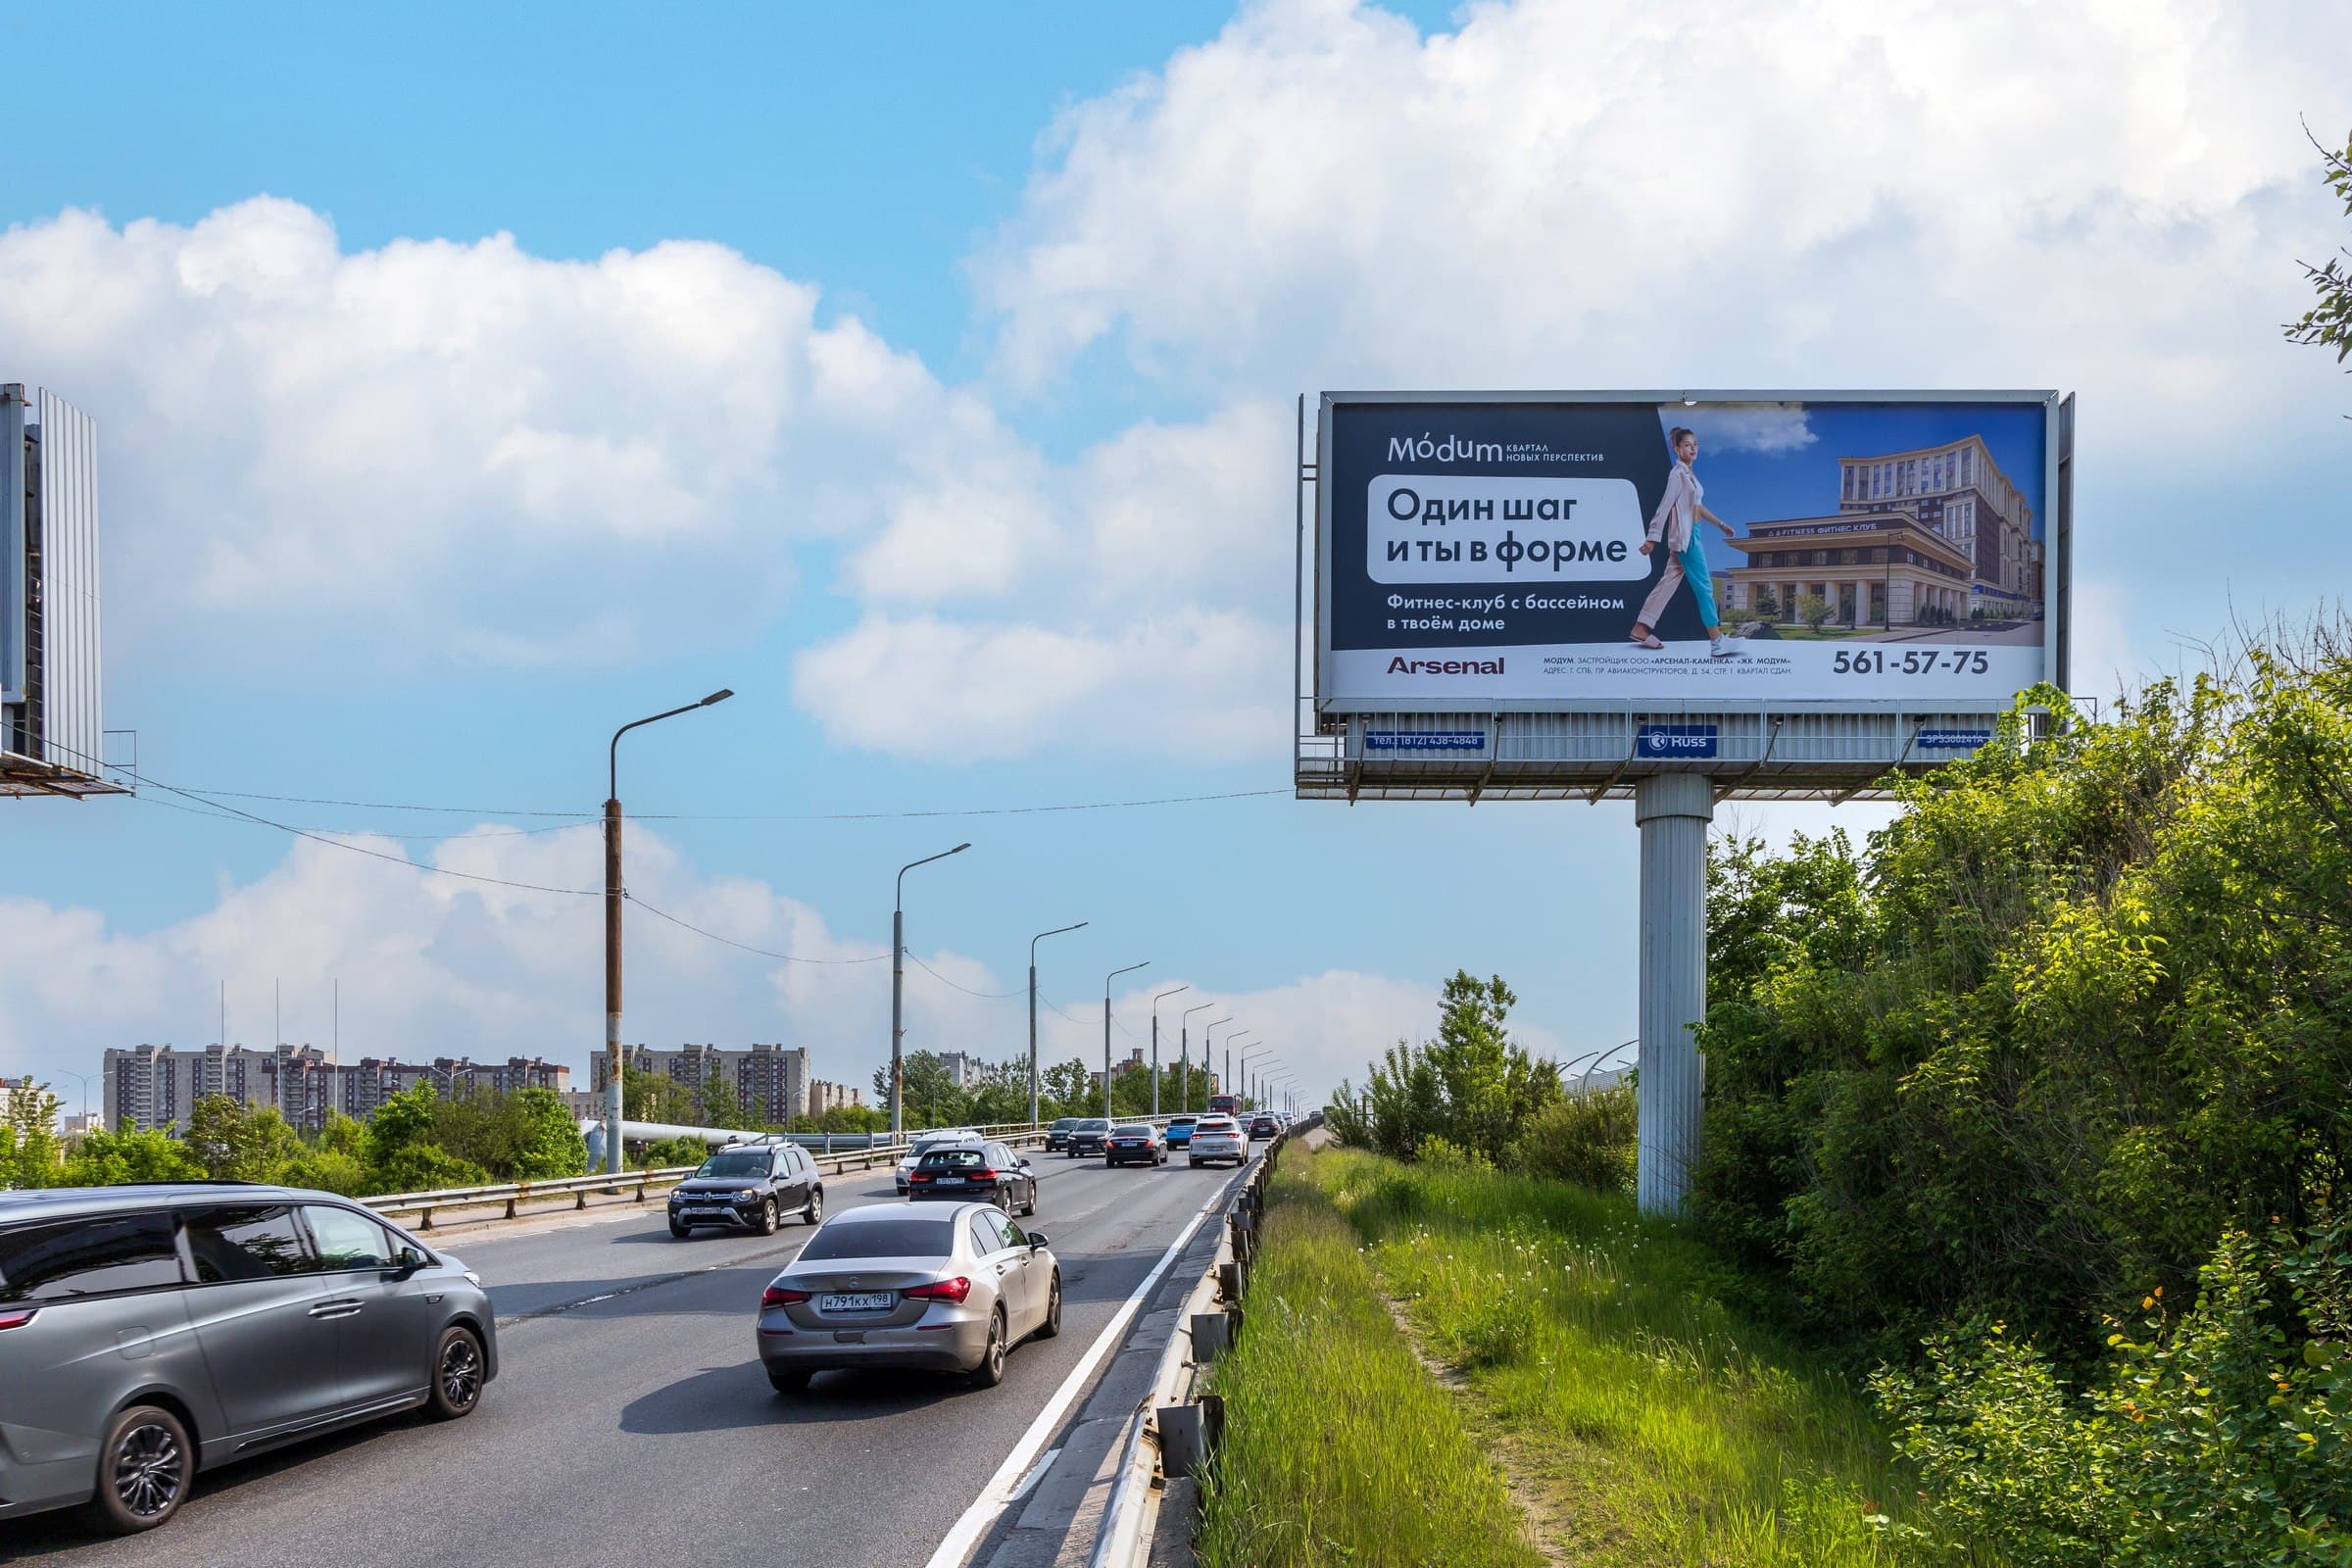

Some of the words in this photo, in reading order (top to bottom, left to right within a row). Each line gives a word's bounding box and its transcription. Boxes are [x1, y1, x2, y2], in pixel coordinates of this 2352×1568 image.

[1387, 431, 1503, 463] Módum
[1387, 487, 1494, 525] Один
[1502, 498, 1577, 520] шаг
[1817, 525, 1852, 534] ФИТНЕС
[1853, 523, 1878, 532] КЛУБ
[1387, 540, 1409, 563] и
[1416, 540, 1461, 563] ты
[1469, 540, 1489, 563] в
[1495, 530, 1628, 572] форме
[1387, 593, 1506, 613] Фитнес-клуб
[1511, 597, 1520, 610] с
[1525, 593, 1625, 610] бассейном
[1387, 618, 1396, 629] в
[1400, 615, 1454, 630] твоём
[1458, 618, 1506, 632] доме
[1386, 657, 1505, 675] Arsenal
[1577, 656, 1628, 665] ЗАСТРОЙЩИК
[1833, 650, 1989, 675] 561-57-75
[1401, 736, 1427, 745] (812)
[1430, 736, 1478, 745] 438-4848
